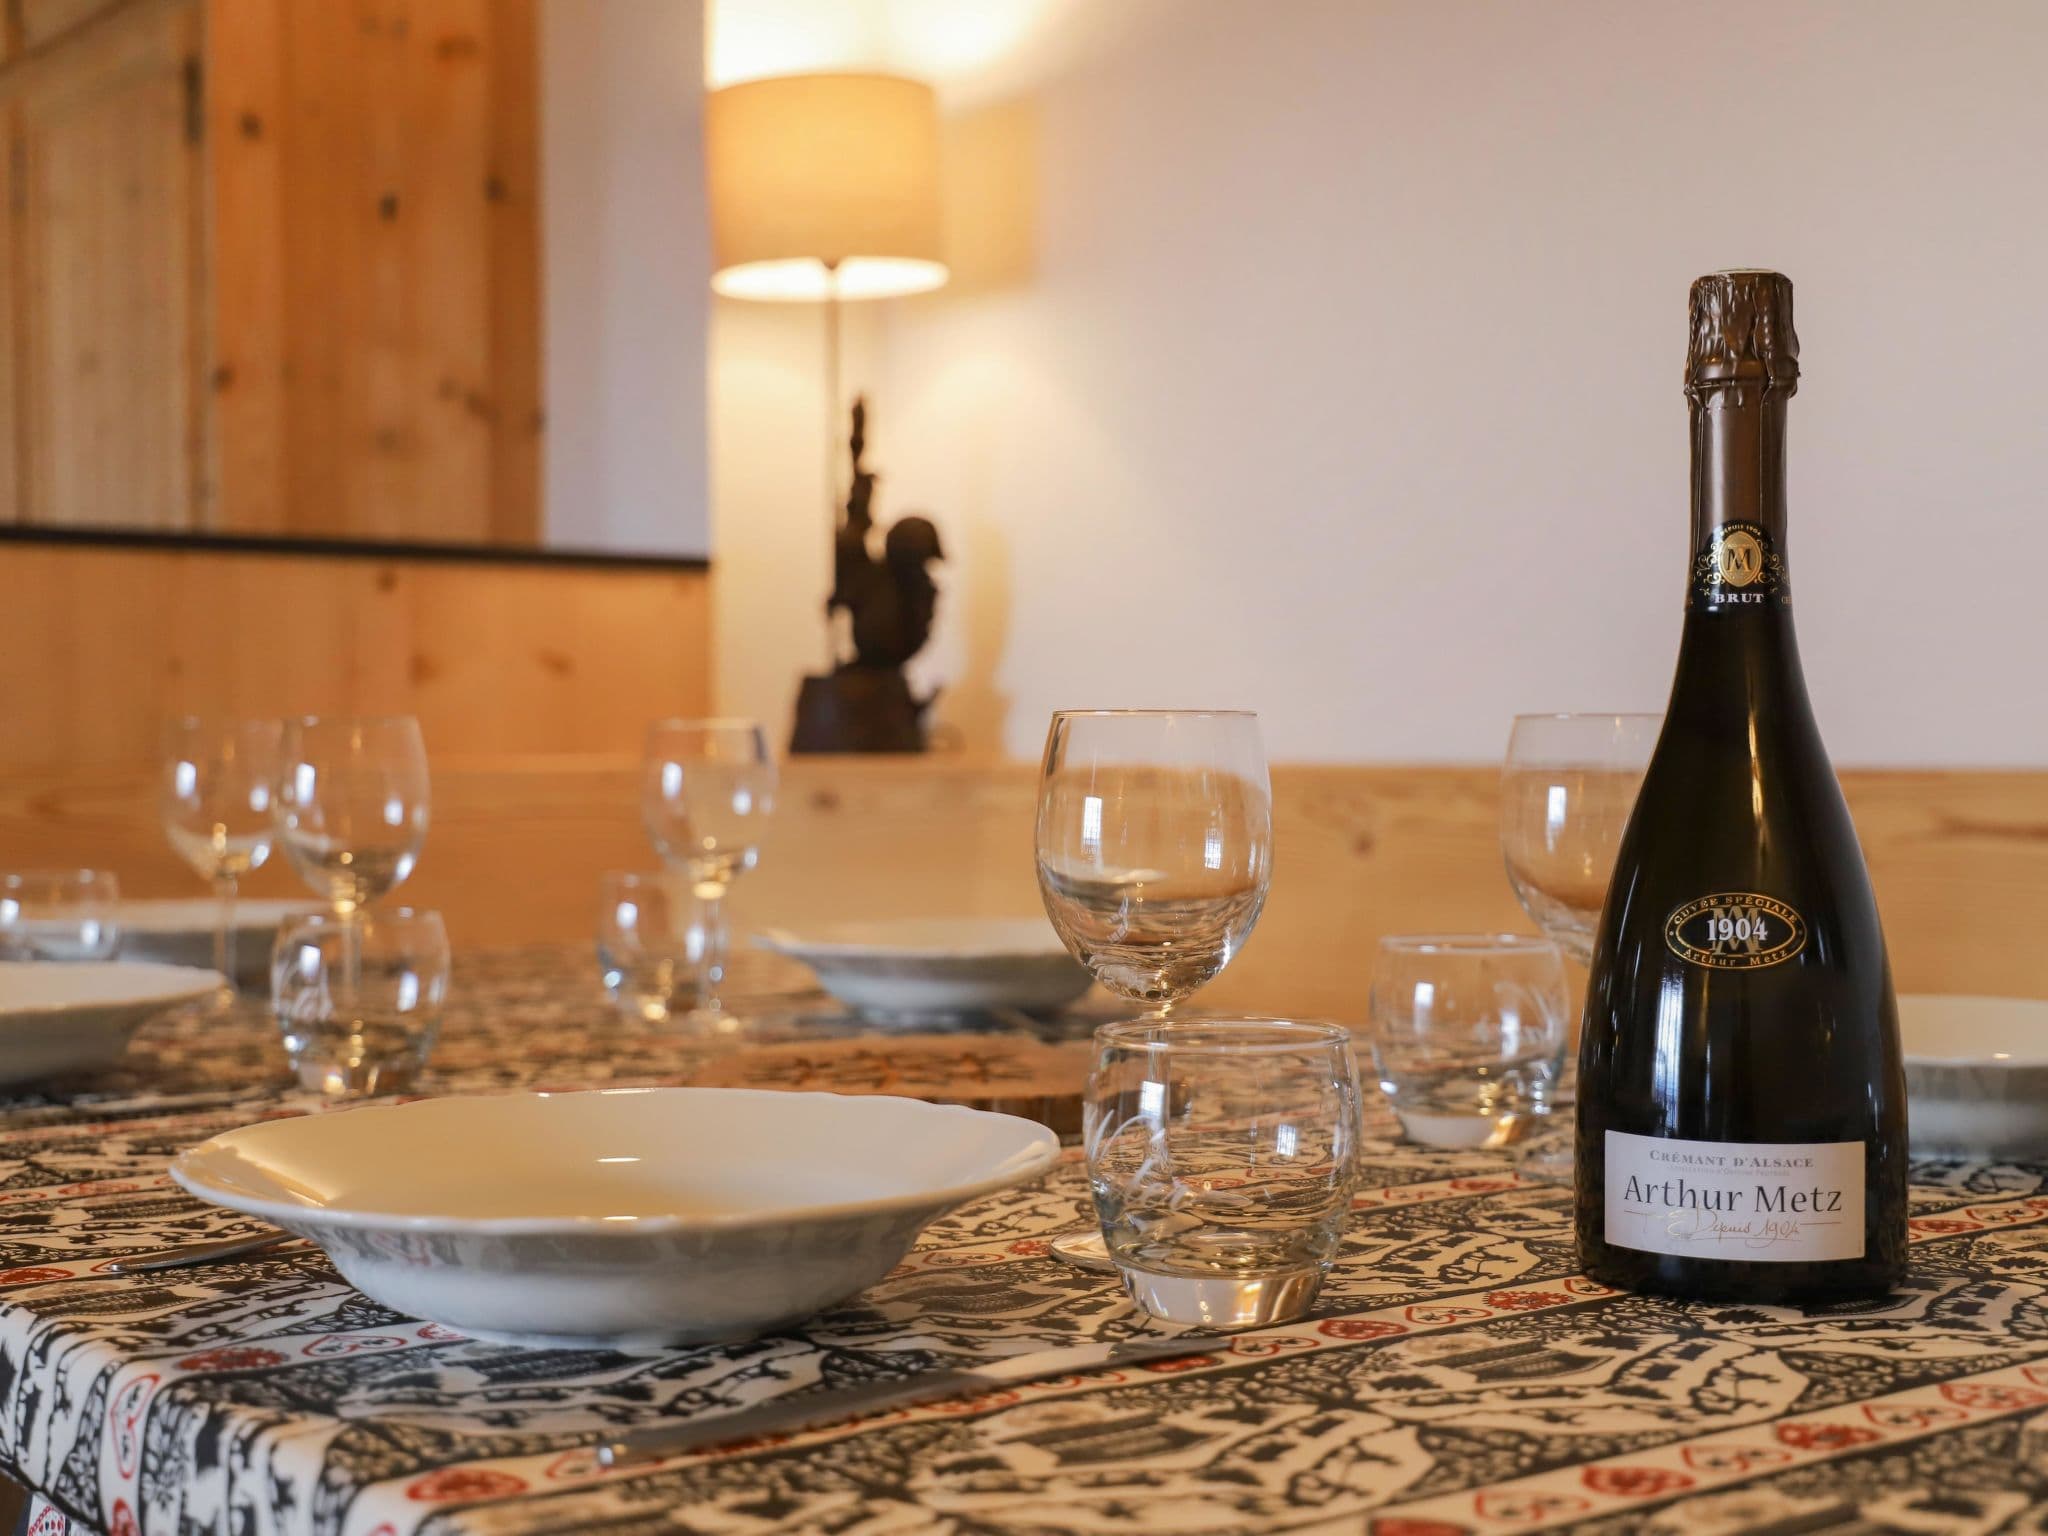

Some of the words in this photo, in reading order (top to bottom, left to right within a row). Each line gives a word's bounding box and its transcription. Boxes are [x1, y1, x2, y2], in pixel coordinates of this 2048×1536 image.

[1714, 593, 1764, 604] BRUT
[1673, 897, 1718, 925] CUVÉE
[1725, 895, 1798, 924] SPÉCIALE
[1706, 916, 1768, 941] 1904
[1683, 948, 1736, 966] Arthur
[1750, 949, 1788, 966] Metz
[1649, 1150, 1726, 1167] CRÉMANT
[1733, 1156, 1814, 1168] D'ALSACE
[1623, 1175, 1743, 1212] Arthur
[1754, 1185, 1842, 1213] Metz
